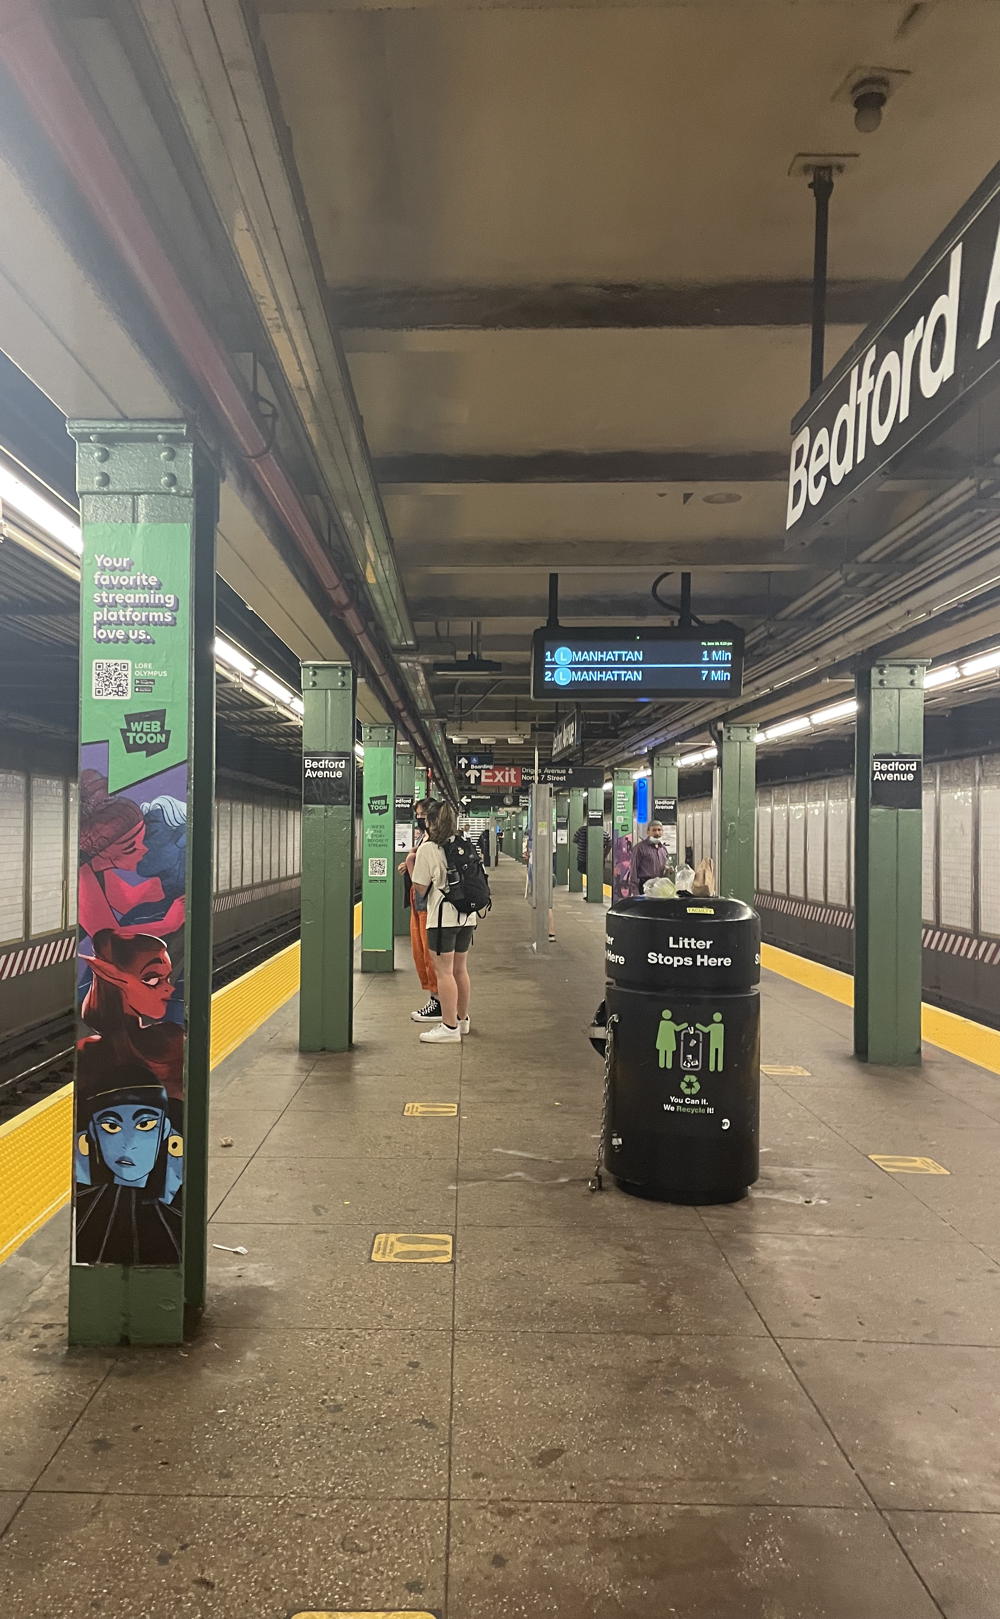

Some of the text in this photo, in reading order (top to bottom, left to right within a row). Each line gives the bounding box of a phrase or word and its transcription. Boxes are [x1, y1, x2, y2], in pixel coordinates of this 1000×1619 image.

[786, 241, 963, 531] Bedford
[94, 554, 131, 568] Your
[93, 571, 159, 586] favorite
[93, 590, 176, 607] streaming
[93, 608, 173, 625] platforms
[93, 626, 151, 640] love us.
[545, 651, 554, 661] 1.
[572, 650, 643, 662] MANHATTAN
[702, 650, 710, 661] 1
[712, 650, 732, 661] Min
[544, 670, 555, 682] 2.
[571, 670, 642, 682] MANHATTAN
[701, 670, 709, 681] 7
[710, 670, 731, 681] Min
[130, 720, 161, 734] WEB
[126, 731, 167, 745] TOON
[304, 759, 346, 769] Bedford
[873, 761, 917, 771] Bedford
[305, 769, 343, 779] Avenue
[480, 766, 517, 784] Exit
[873, 771, 915, 781] Avenue
[668, 936, 714, 950] Litter
[647, 952, 732, 967] Stops Here
[669, 1095, 684, 1104] You
[663, 1103, 676, 1112] We
[676, 1105, 706, 1115] Recycle
